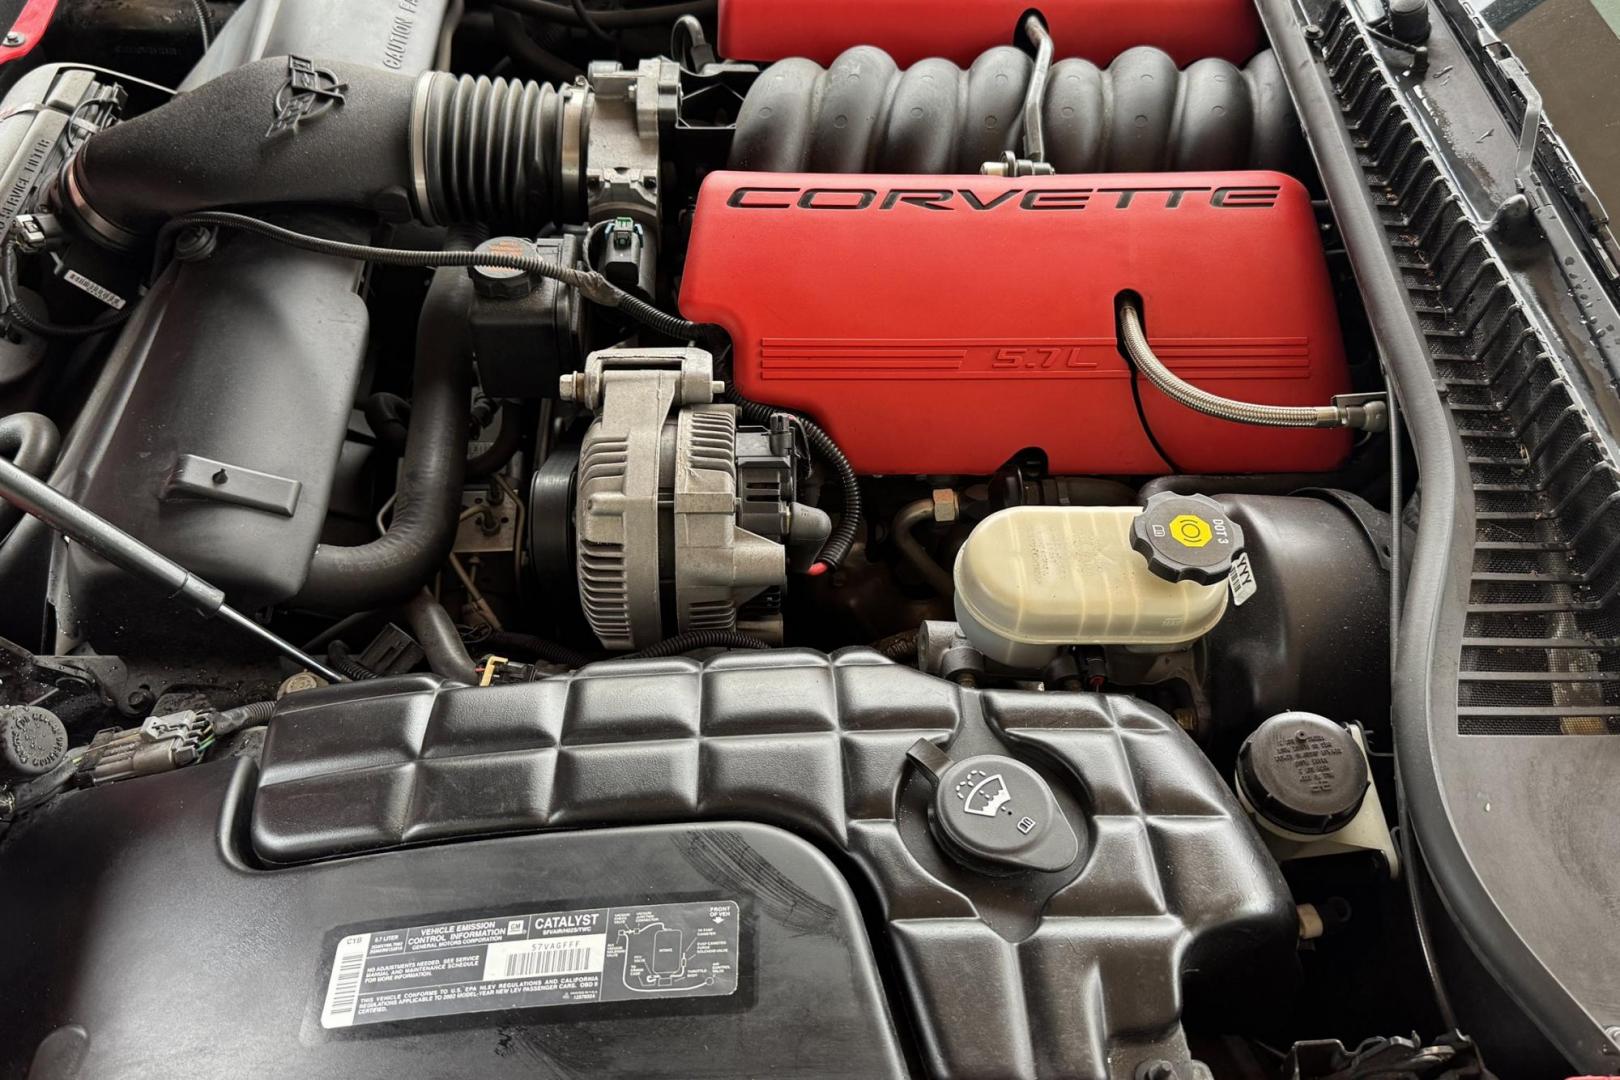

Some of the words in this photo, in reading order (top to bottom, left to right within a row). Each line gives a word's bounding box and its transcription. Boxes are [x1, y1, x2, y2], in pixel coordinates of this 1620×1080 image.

[383, 16, 413, 70] CAUTION
[2, 178, 30, 219] SERVICE
[24, 139, 50, 172] FILTER
[726, 185, 1281, 211] CORVETTE
[992, 347, 1098, 368] 5.7L
[1213, 519, 1227, 537] DOT
[1218, 537, 1229, 545] 3
[1237, 557, 1251, 585] YYY
[420, 926, 454, 935] VEHICLE
[456, 920, 495, 931] EMISSION
[535, 913, 599, 929] CATALYST
[407, 934, 446, 944] CONTROL
[450, 927, 506, 939] INFORMATION
[411, 942, 438, 950] GENERAL
[438, 939, 462, 947] MOTORS
[462, 935, 502, 944] CORPORATION
[376, 962, 416, 971] ADJUSTMENTS
[404, 963, 446, 972] MAINTENANCE
[447, 960, 478, 968] SCHEDULE
[394, 971, 432, 979] INFORMATION.
[403, 990, 438, 998] CONFORMS
[498, 979, 542, 988] REGULATIONS
[560, 974, 598, 983] CALIFORNIA
[358, 1000, 398, 1008] REGULATIONS
[398, 996, 433, 1004] APPLICABLE
[456, 989, 495, 998] MODEL-YEAR
[522, 984, 557, 992] PASSENGER
[357, 1006, 388, 1014] CERTIFIED.
